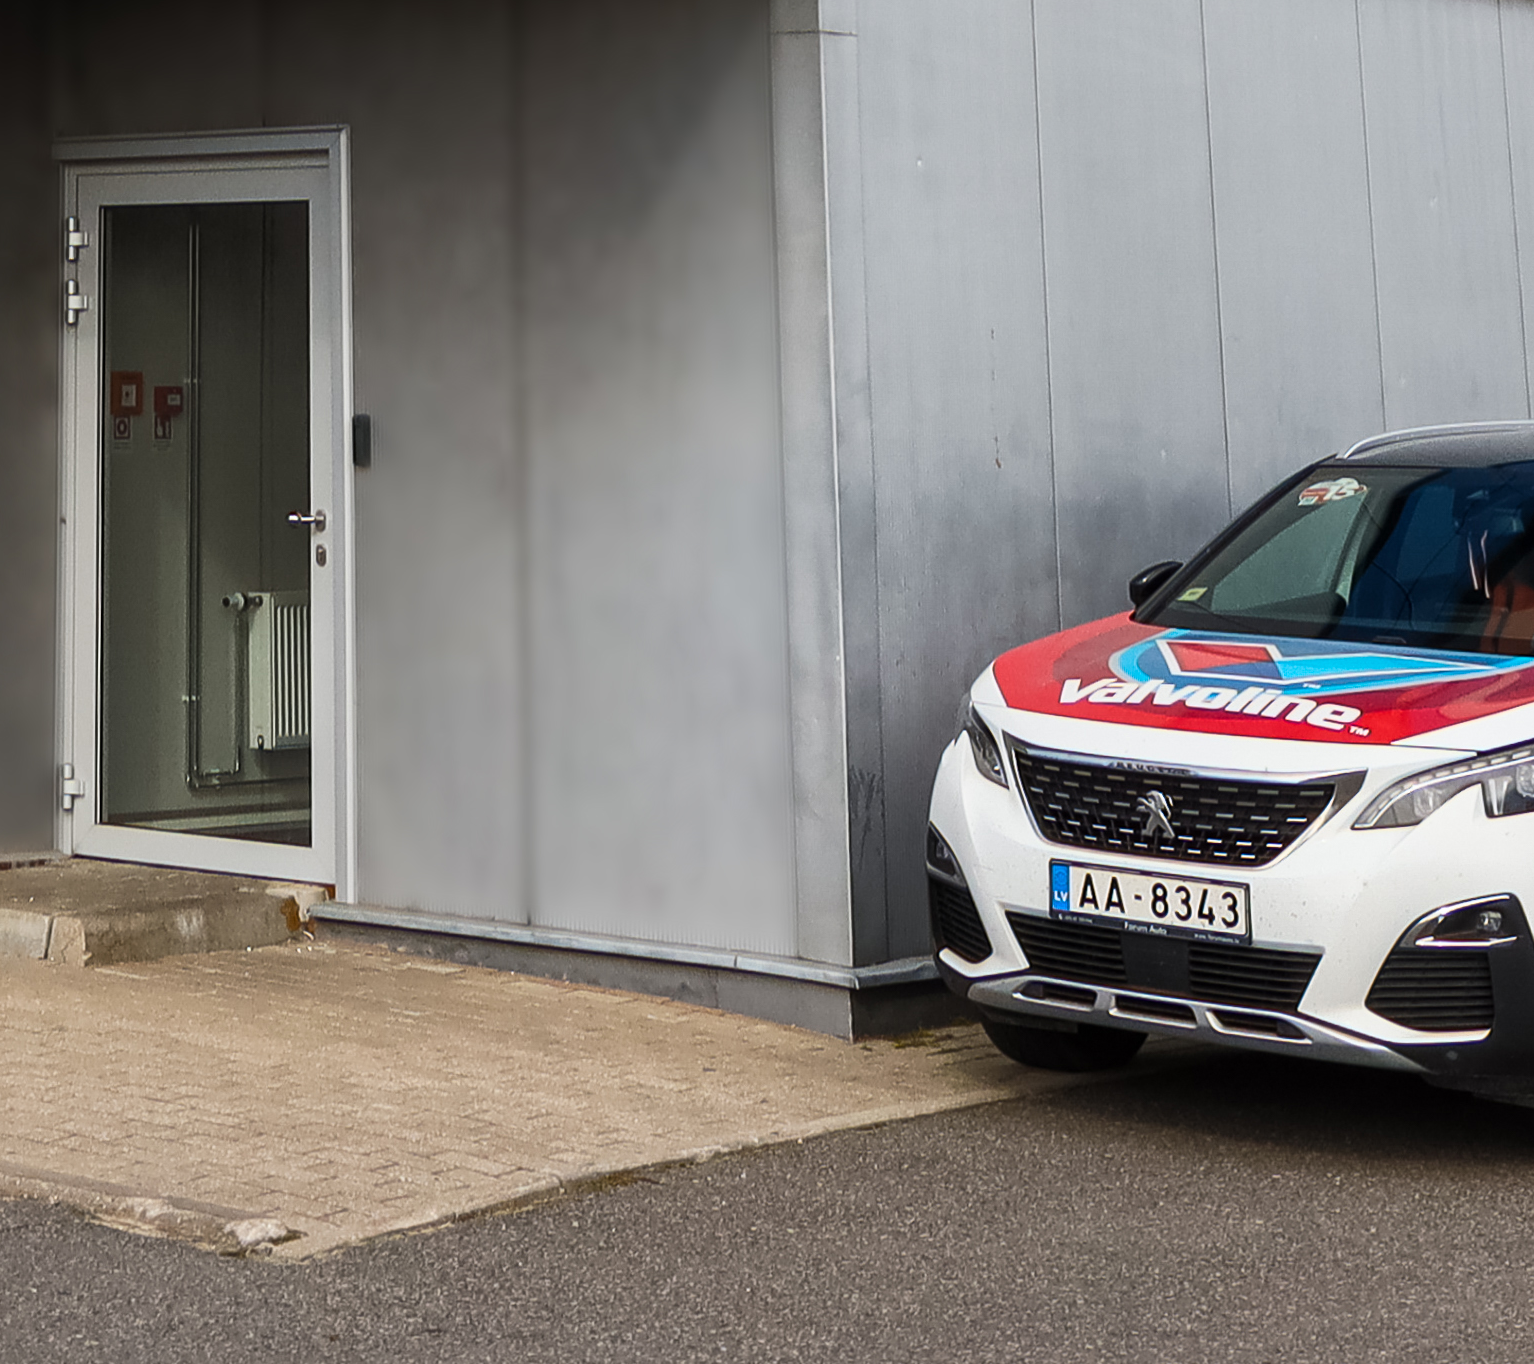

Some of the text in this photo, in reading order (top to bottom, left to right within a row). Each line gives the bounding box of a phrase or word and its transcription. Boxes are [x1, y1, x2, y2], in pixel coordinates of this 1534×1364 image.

[1058, 678, 1362, 731] Valvoline
[1053, 890, 1069, 902] LV
[1124, 921, 1168, 937] Forum Auto
